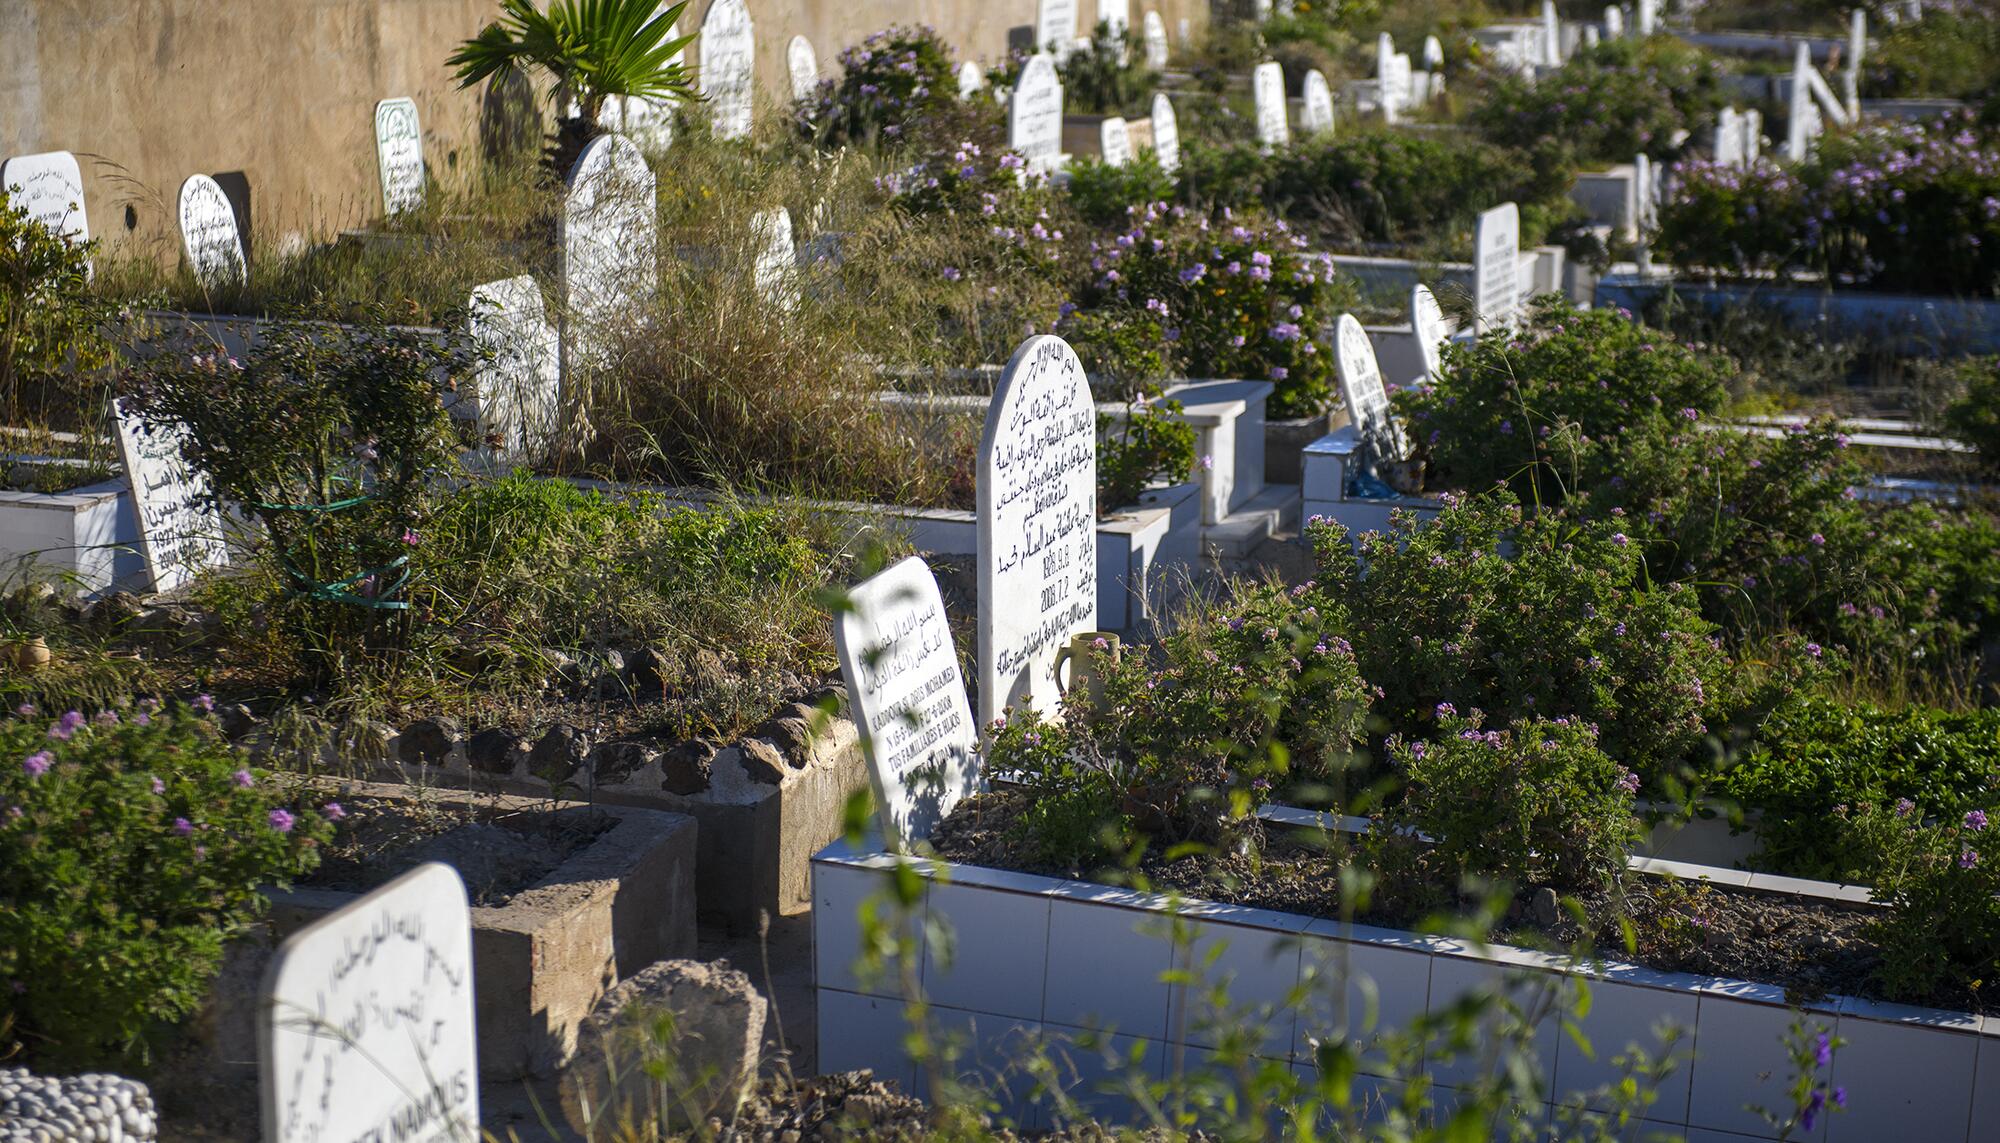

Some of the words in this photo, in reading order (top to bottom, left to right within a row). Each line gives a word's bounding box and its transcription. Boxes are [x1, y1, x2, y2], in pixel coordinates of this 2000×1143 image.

[924, 665, 956, 697] MOHAMED
[888, 753, 903, 773] TUS
[901, 726, 939, 764] FAMILIARES
[937, 723, 943, 738] E
